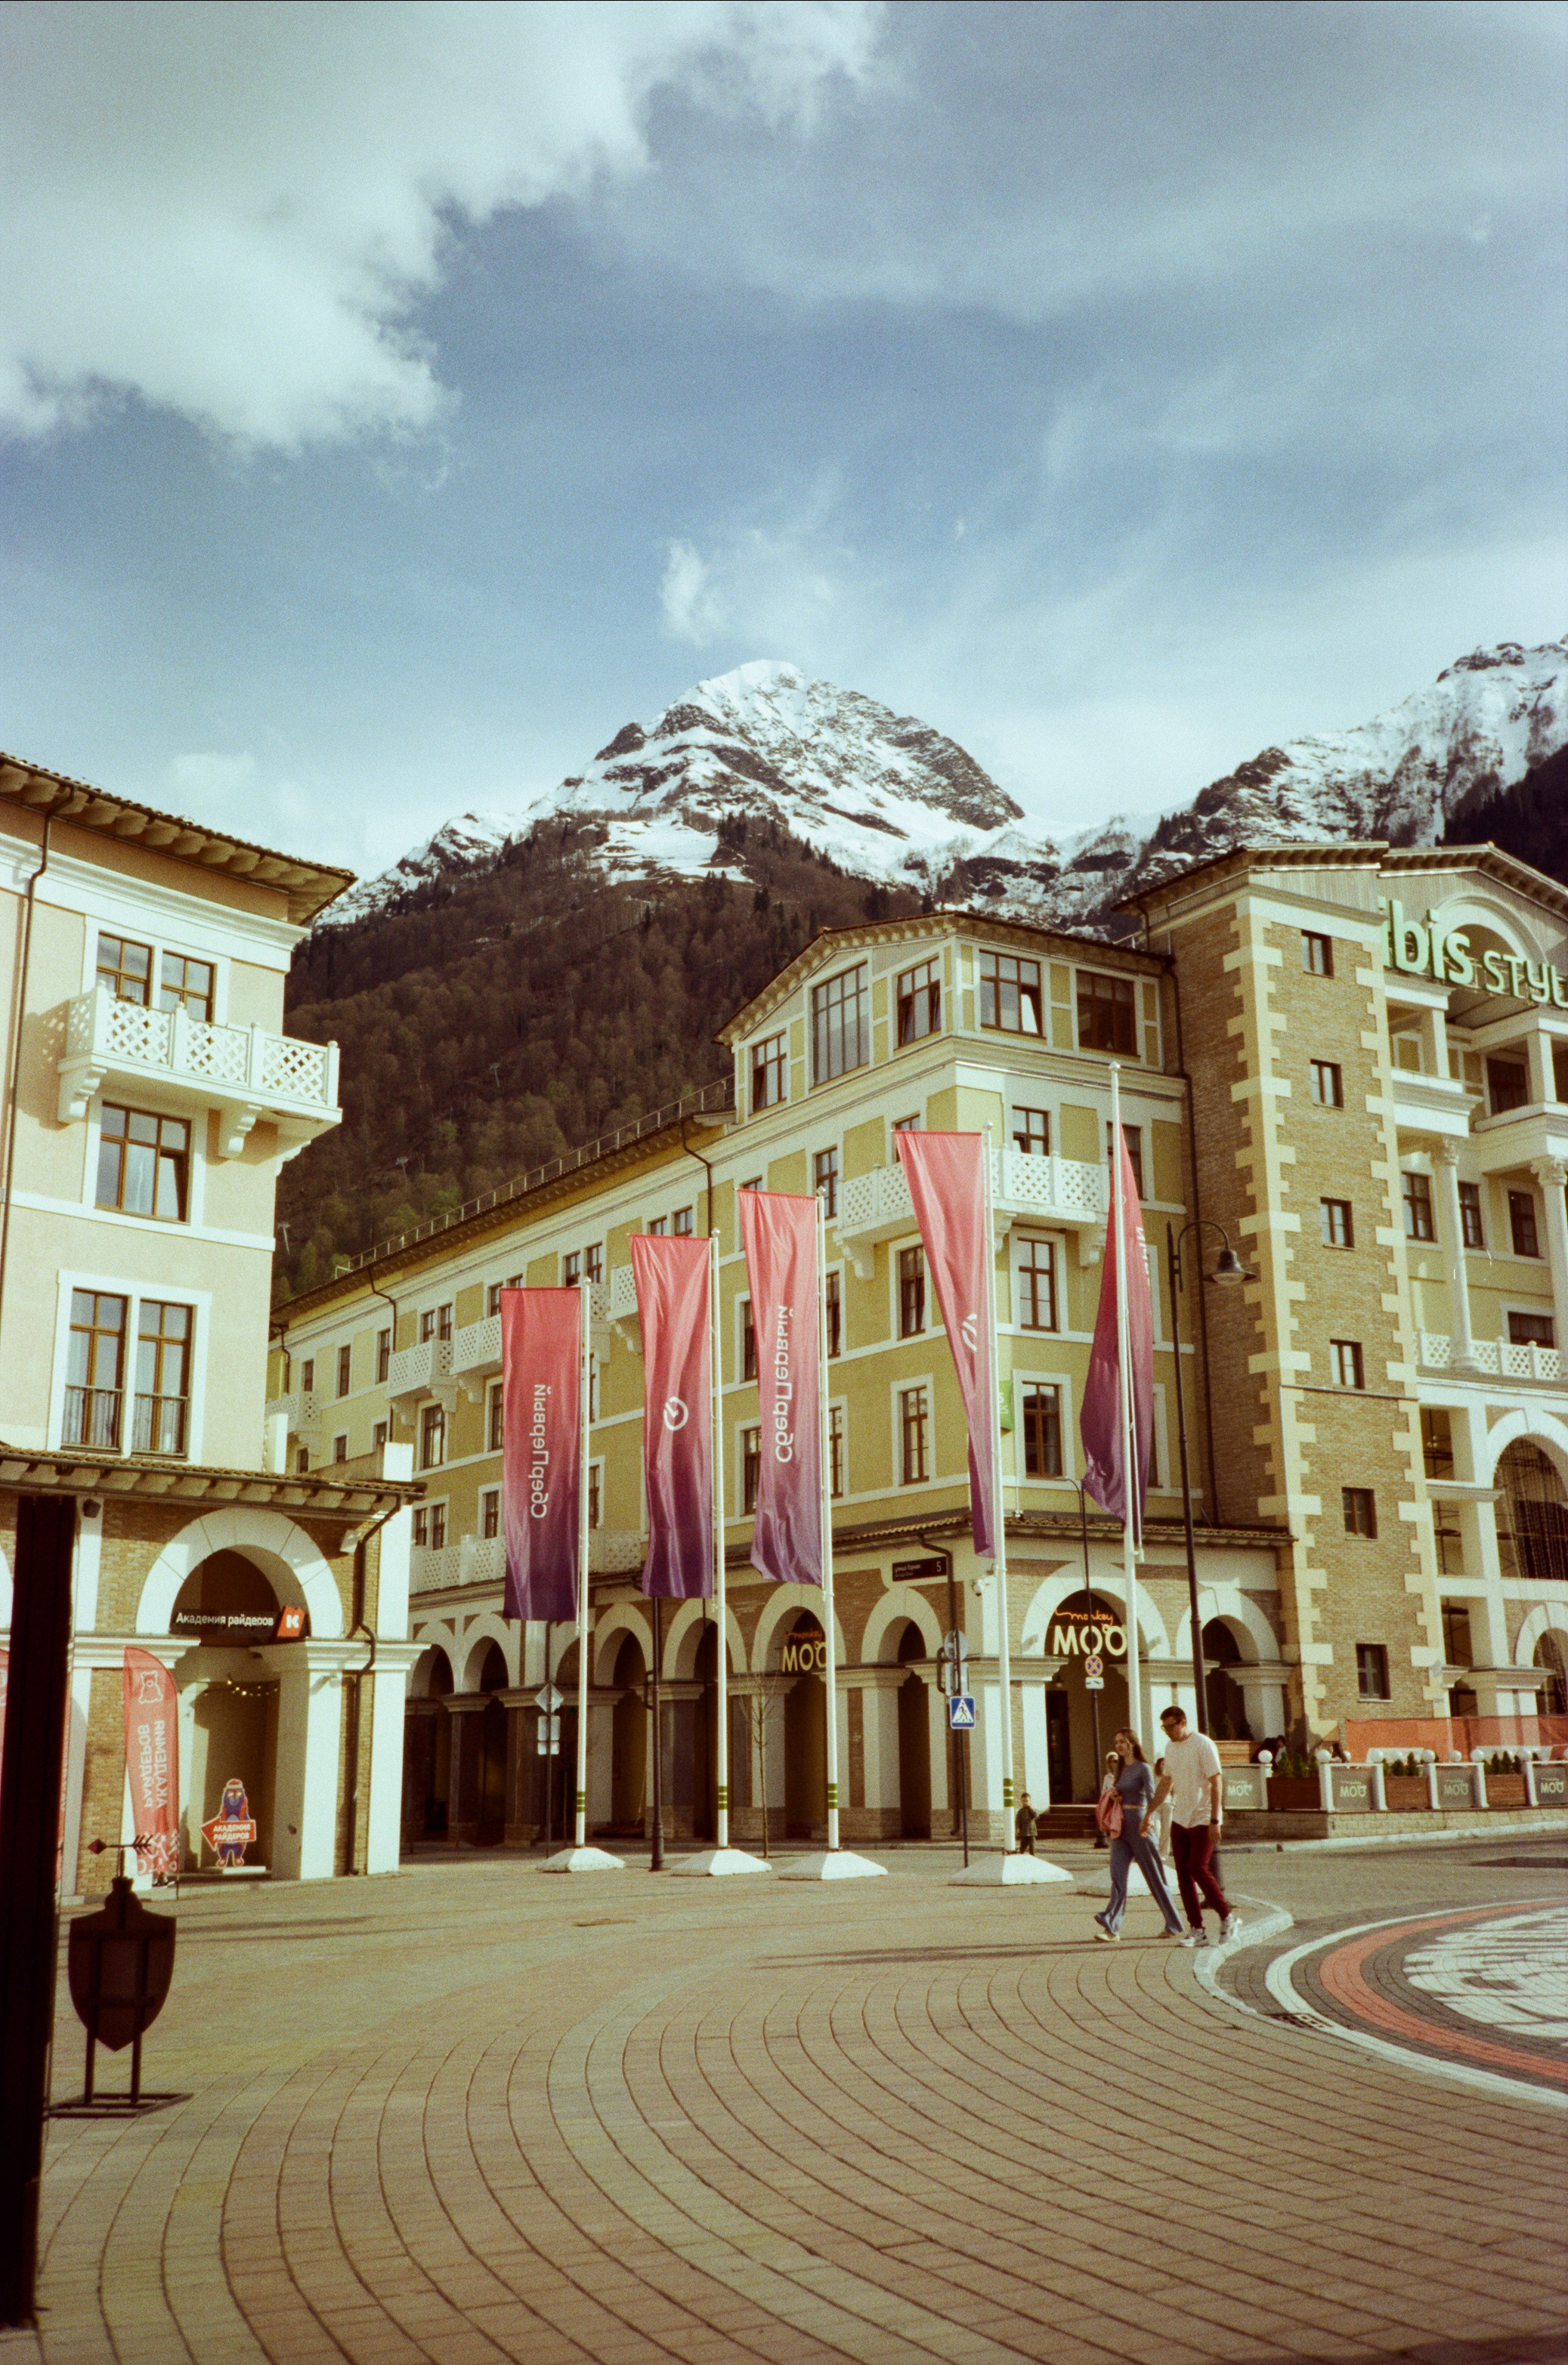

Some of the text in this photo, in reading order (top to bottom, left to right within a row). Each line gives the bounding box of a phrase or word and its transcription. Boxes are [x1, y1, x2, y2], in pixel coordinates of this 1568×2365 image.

[1378, 896, 1568, 1007] ibis STYL
[936, 1561, 942, 1572] 5
[176, 1612, 226, 1625] Академия
[228, 1614, 274, 1628] райдеров
[1055, 1609, 1114, 1627] monkey
[212, 1824, 251, 1832] АКАДЕМИЯ
[213, 1832, 250, 1841] РАЙДЕРОВ
